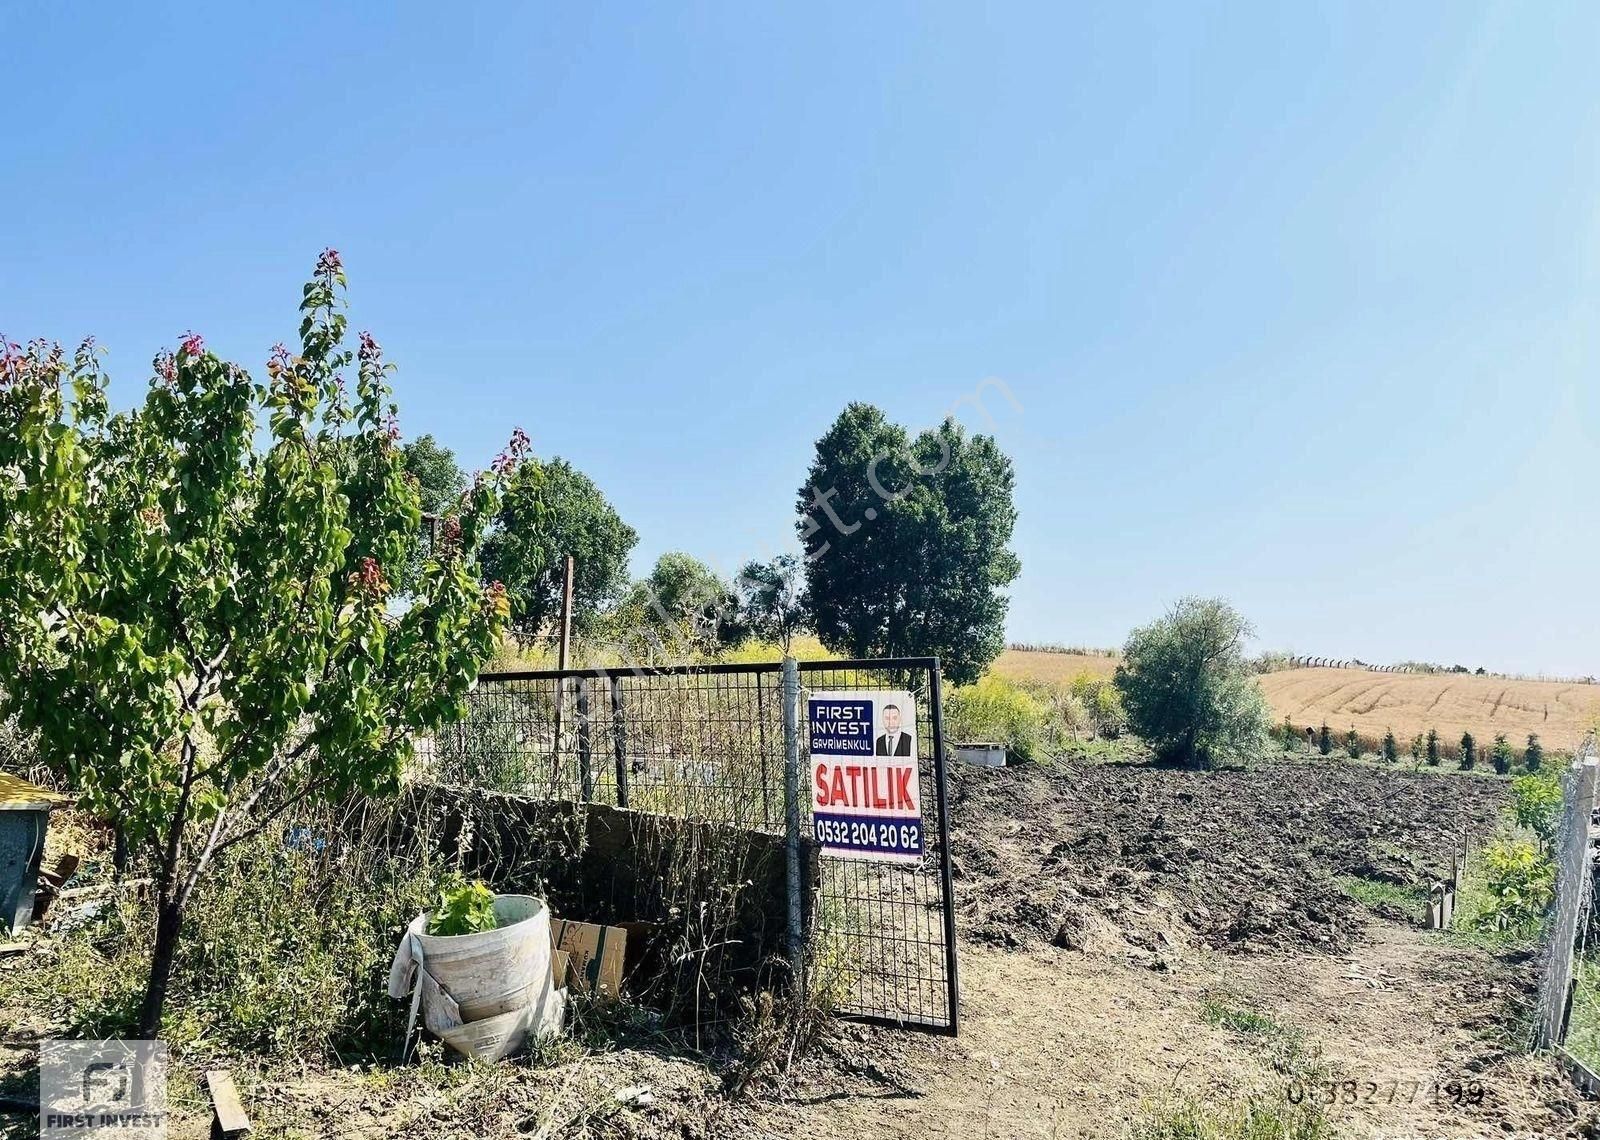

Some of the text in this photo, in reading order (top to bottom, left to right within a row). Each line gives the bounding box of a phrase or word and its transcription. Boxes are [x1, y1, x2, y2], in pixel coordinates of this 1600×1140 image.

[816, 706, 864, 719] FIRST
[812, 721, 870, 735] INVEST
[812, 737, 871, 750] GAYRİMENKUL
[815, 763, 915, 810] SATILIK
[817, 819, 919, 849] 0532 204 20 62
